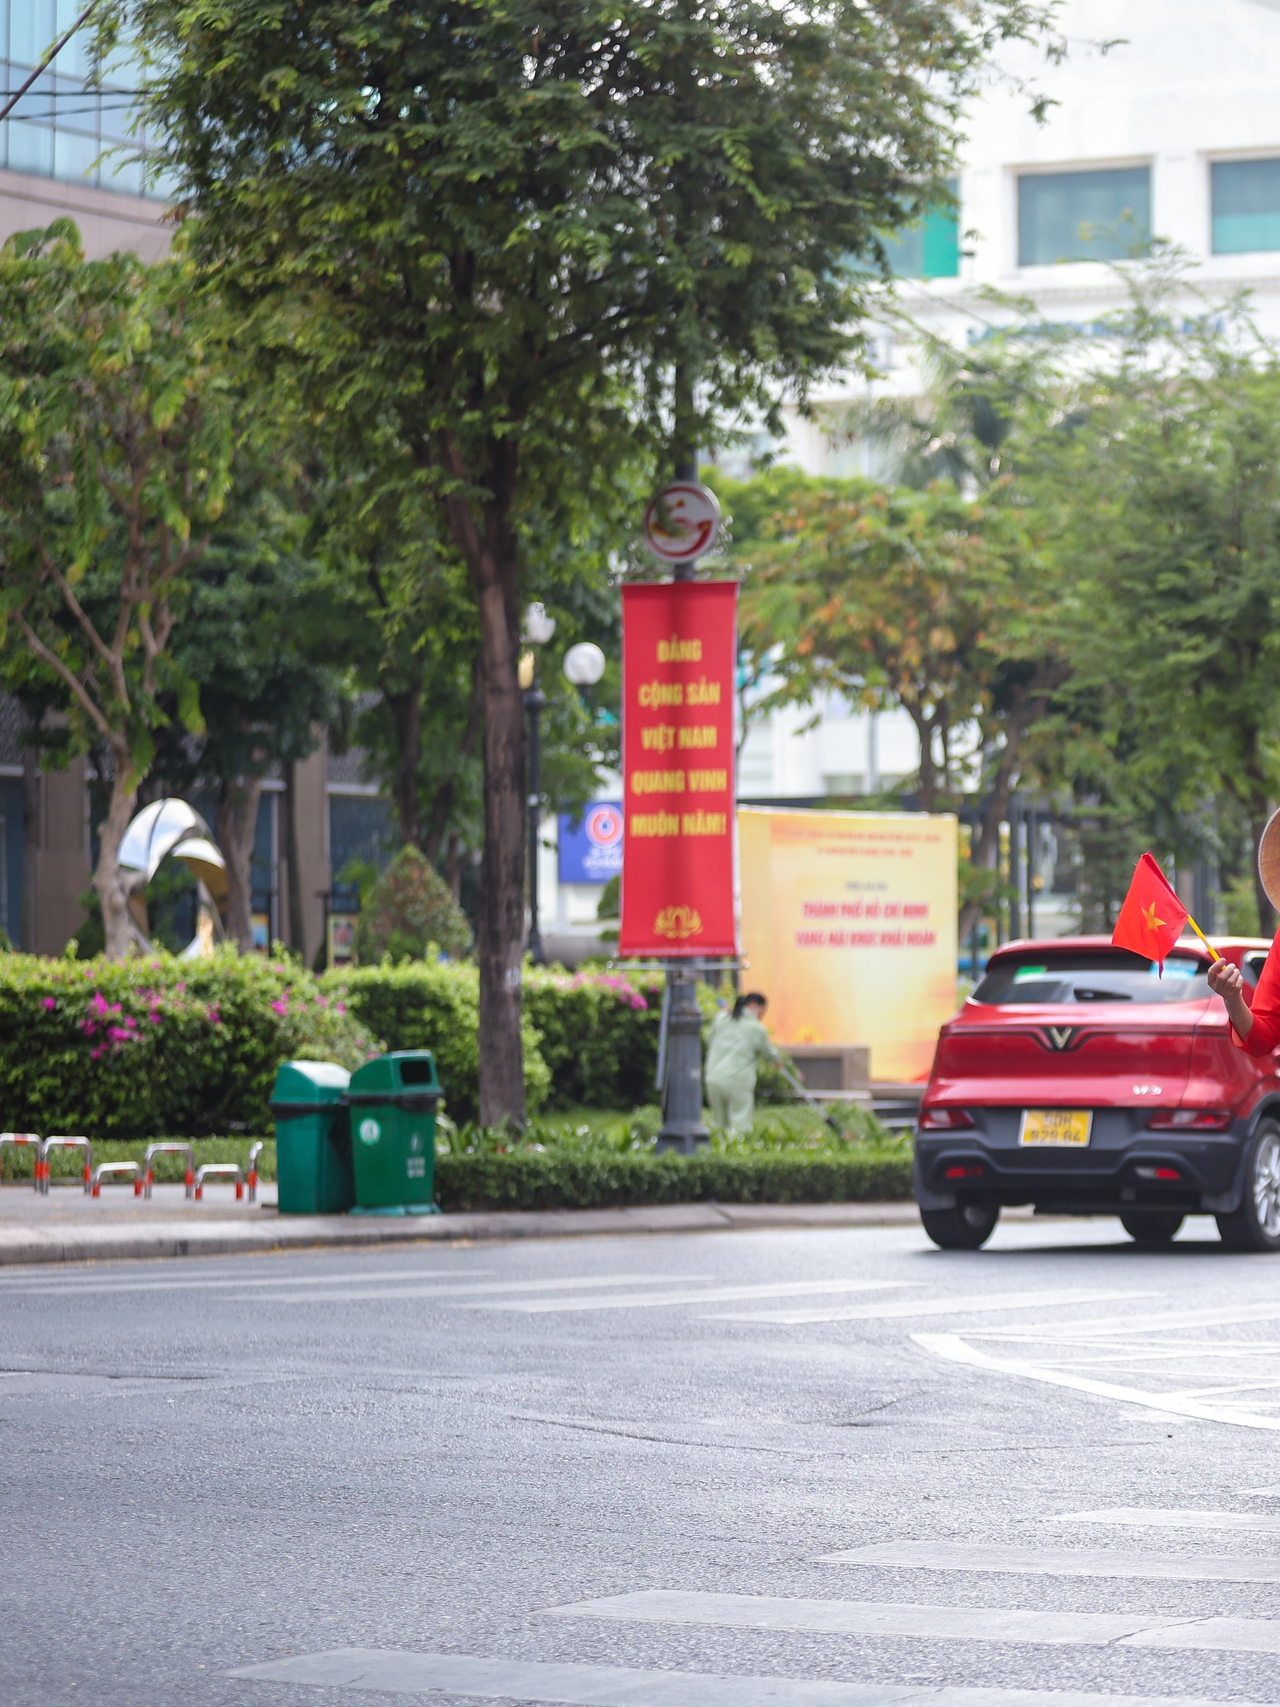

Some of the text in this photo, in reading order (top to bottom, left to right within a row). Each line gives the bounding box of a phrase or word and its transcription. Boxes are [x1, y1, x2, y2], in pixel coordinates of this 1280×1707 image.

[656, 633, 703, 663] ĐẢNG
[637, 675, 722, 711] CỘNG SẢN
[640, 723, 718, 755] VIỆT NAM
[630, 768, 728, 796] QUANG VINH
[629, 809, 680, 838] MUÔN
